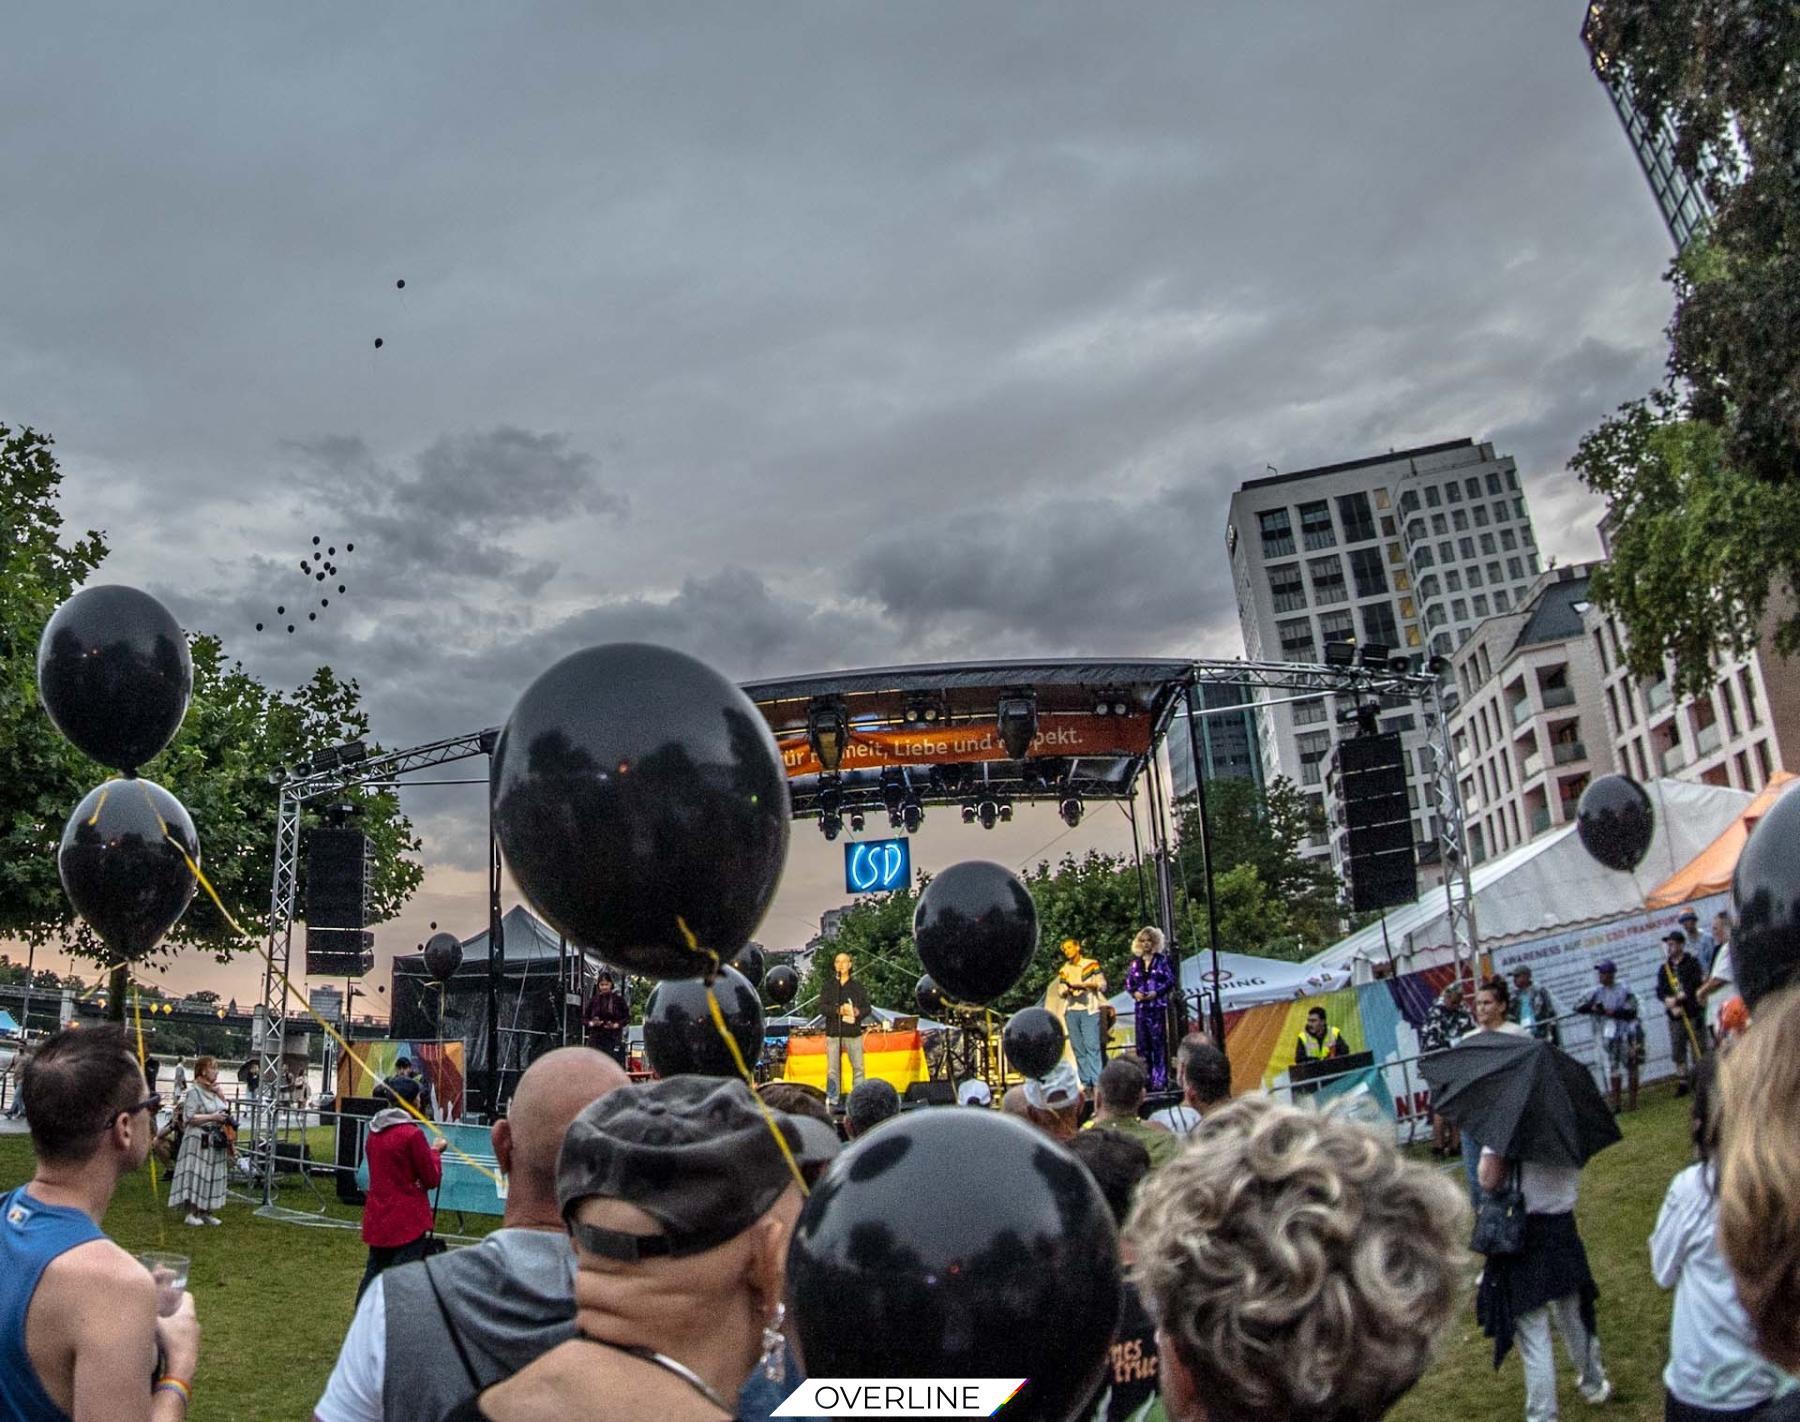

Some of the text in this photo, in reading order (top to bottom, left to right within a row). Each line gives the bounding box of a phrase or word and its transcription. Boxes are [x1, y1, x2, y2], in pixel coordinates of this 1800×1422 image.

[780, 750, 804, 766] ür
[894, 738, 948, 756] Liebe
[954, 733, 992, 753] und
[996, 726, 1083, 751] pekt.
[1502, 944, 1562, 966] AWARENESS
